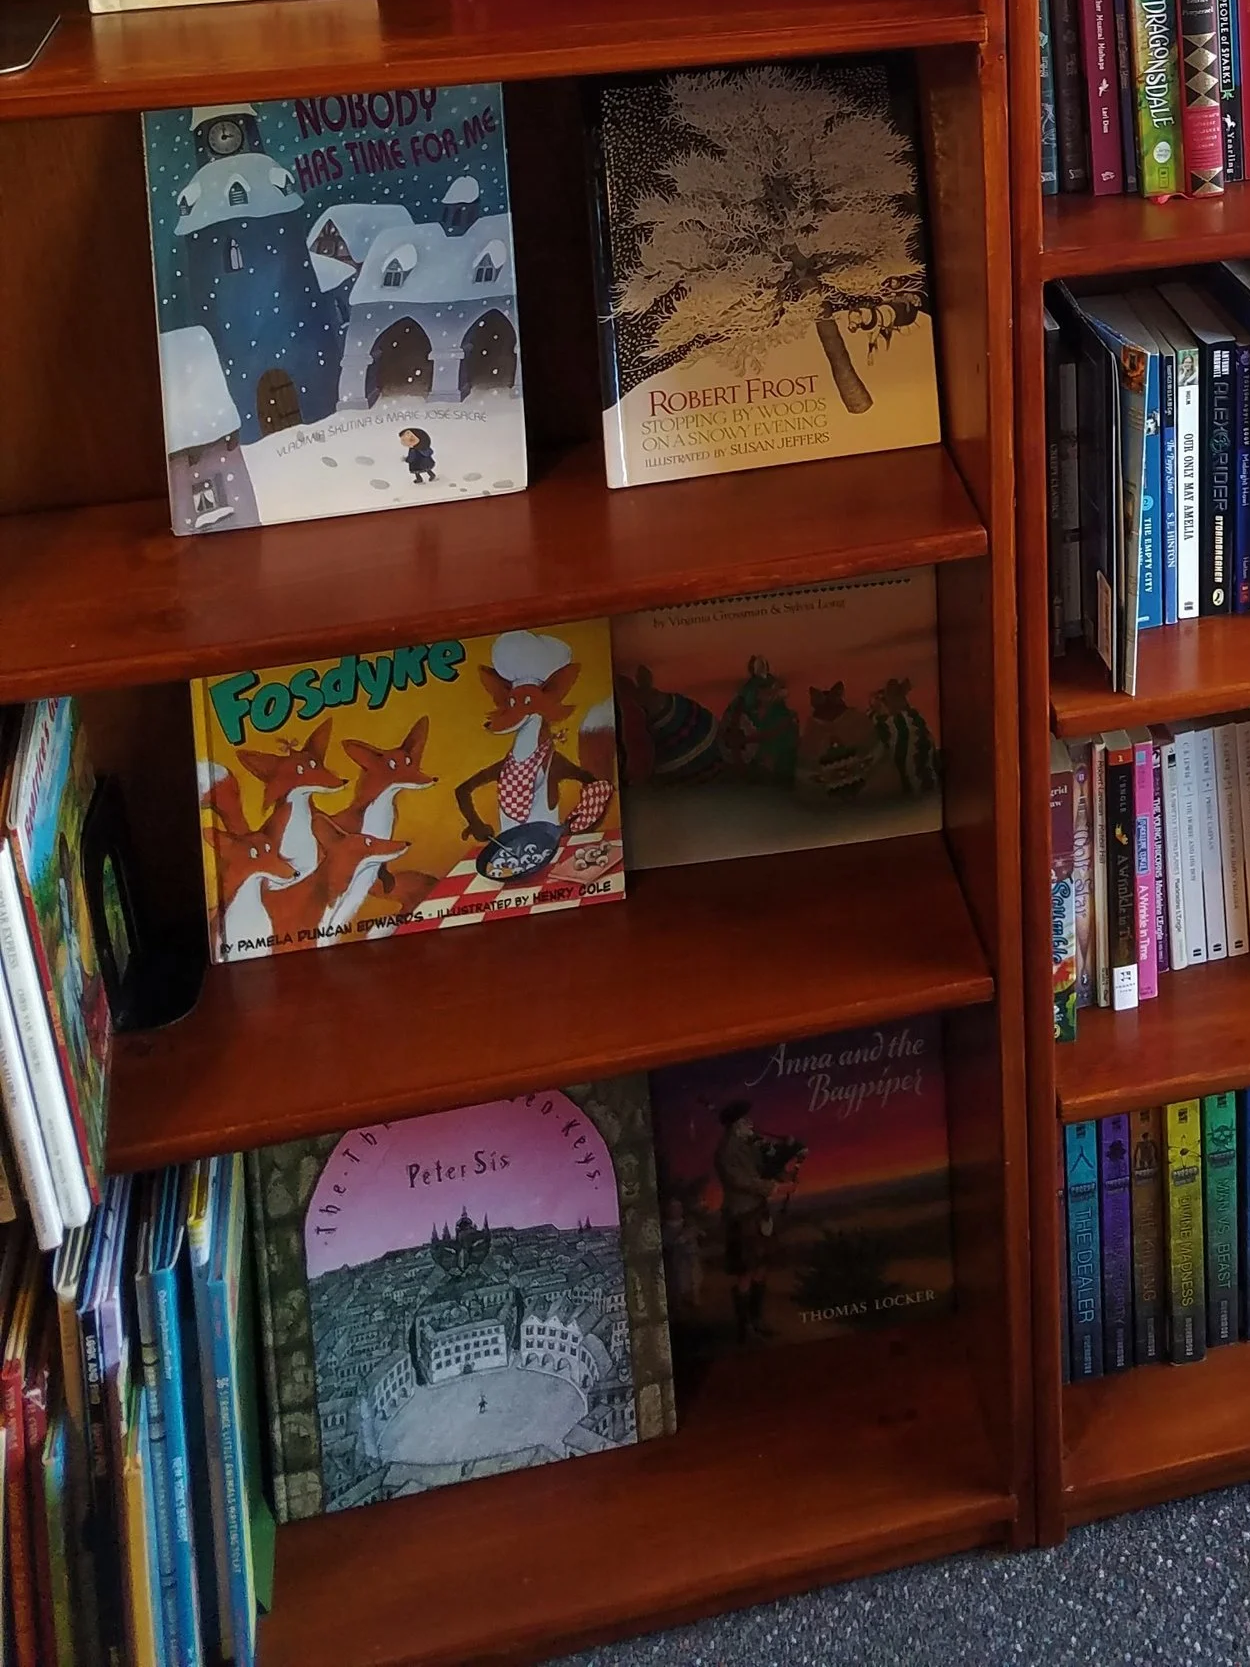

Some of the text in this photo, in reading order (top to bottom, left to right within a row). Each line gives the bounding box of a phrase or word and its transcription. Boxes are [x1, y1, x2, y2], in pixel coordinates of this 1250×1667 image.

[1141, 0, 1175, 129] DRAGONSDALE
[294, 87, 439, 140] NOBODY
[294, 105, 498, 193] HAS TIME FOR ME
[640, 397, 828, 436] STOPPING BY WOODS
[648, 374, 820, 417] ROBERT FROST
[641, 413, 829, 453] ON A SNOWY EVENING
[714, 445, 728, 459] BY
[729, 438, 775, 457] SUSAN
[776, 431, 831, 450] JEFFERS
[1184, 433, 1195, 542] OUR ONLY MAY AMELIA
[1212, 453, 1230, 512] RIDER
[437, 881, 613, 919] ILLUSTRATED BY HENRY COLE
[236, 911, 425, 952] PAMELA DUNCAN EDWARDS
[744, 1028, 925, 1087] Anna and the
[807, 1066, 924, 1120] Bagpiper
[406, 1162, 468, 1189] Peter
[1076, 1208, 1093, 1243] THE
[800, 1288, 936, 1324] THOMAS LOCKER
[1077, 1247, 1096, 1324] DEALER
